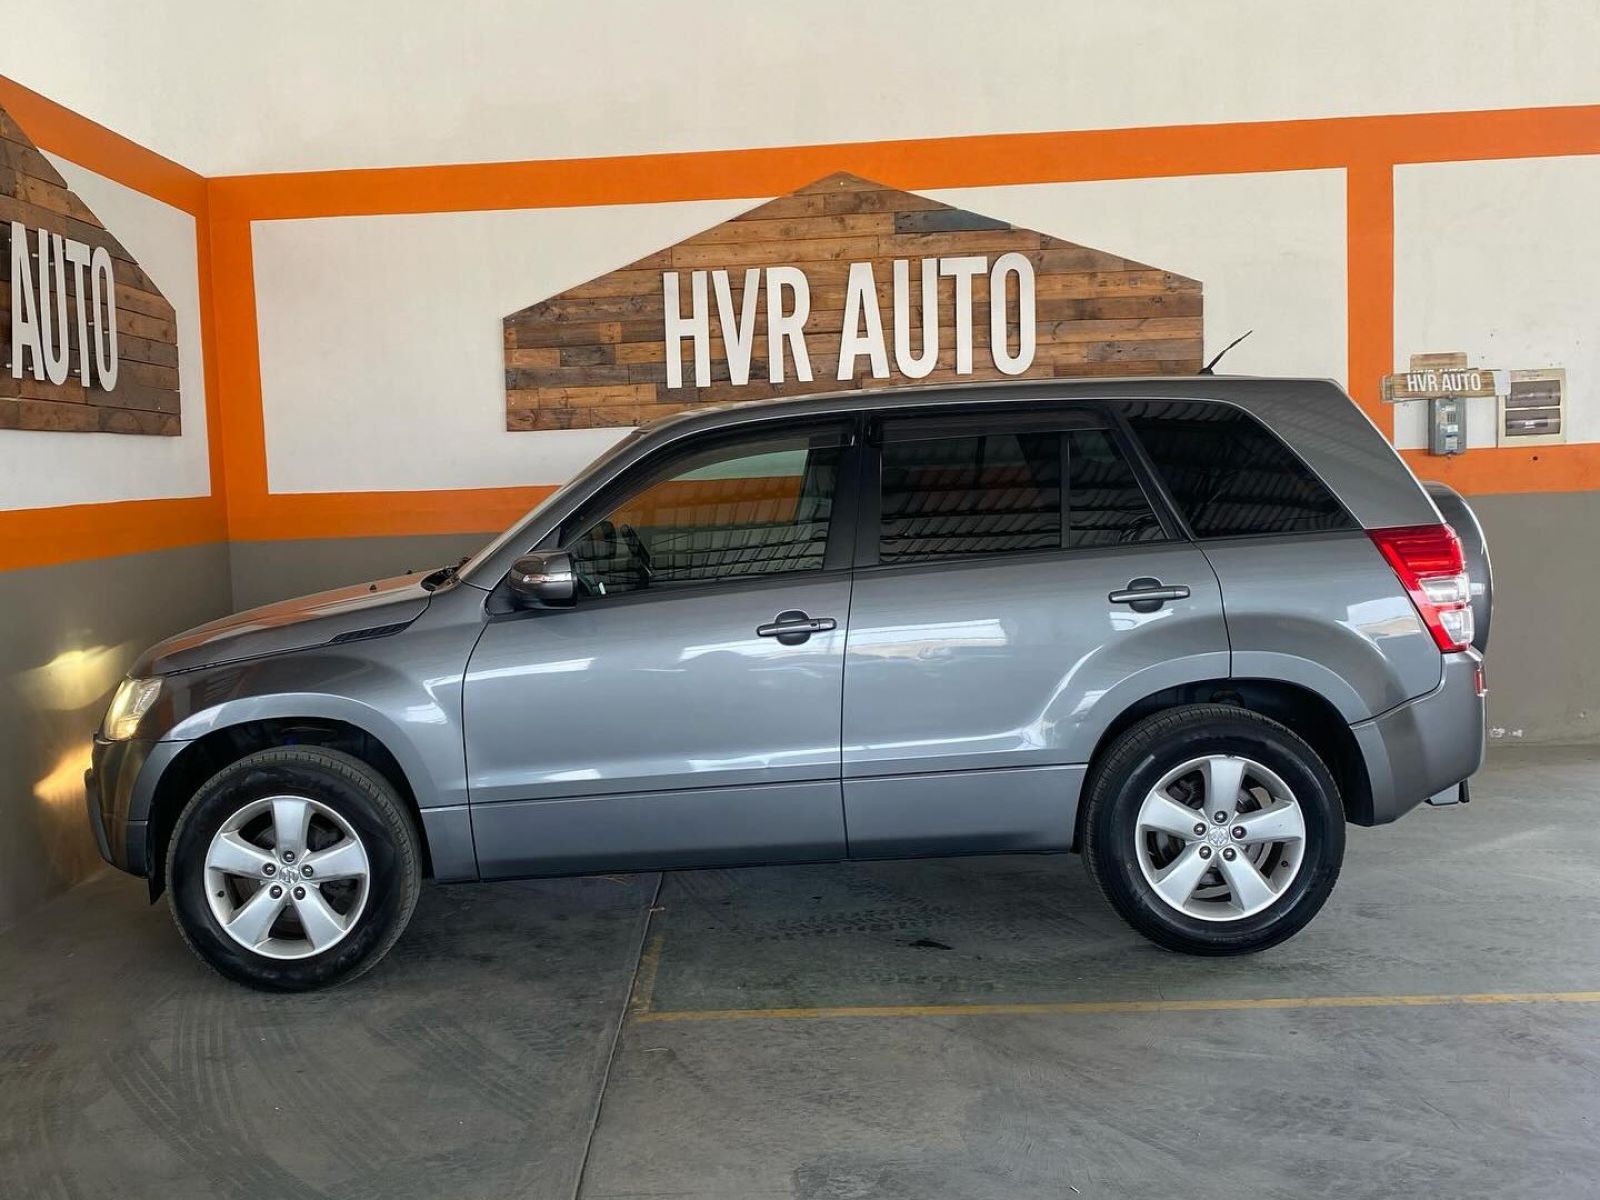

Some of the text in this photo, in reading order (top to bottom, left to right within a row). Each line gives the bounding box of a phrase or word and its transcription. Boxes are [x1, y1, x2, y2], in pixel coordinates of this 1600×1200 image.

[11, 221, 118, 391] AUTO
[664, 252, 1036, 389] HVR AUTO
